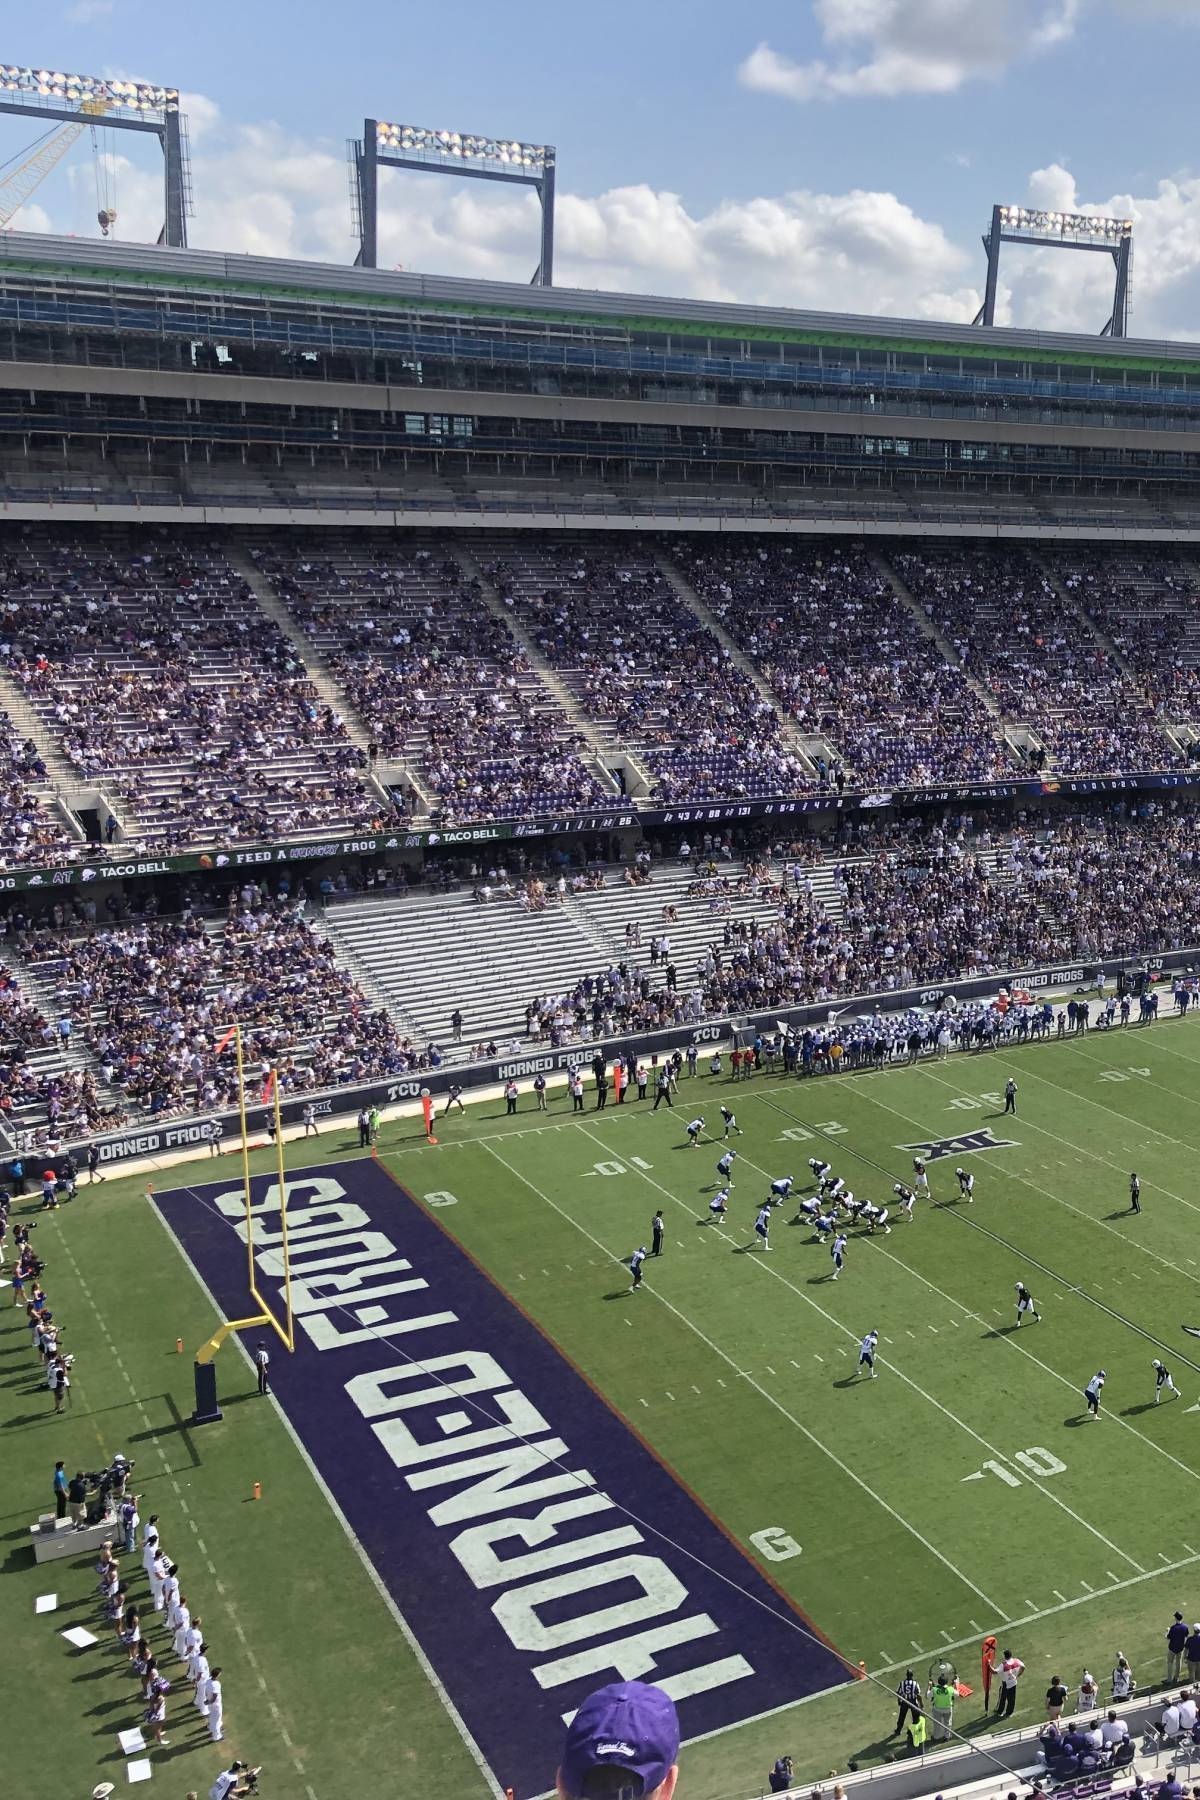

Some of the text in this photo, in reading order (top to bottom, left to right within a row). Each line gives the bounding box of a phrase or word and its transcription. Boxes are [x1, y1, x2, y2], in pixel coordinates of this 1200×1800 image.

[619, 816, 632, 826] 26
[678, 812, 690, 820] 43
[738, 807, 751, 816] 131
[404, 835, 422, 847] AT
[442, 831, 472, 842] TACO
[472, 828, 500, 839] BELL
[237, 840, 376, 864] FEED A HUNGRY FROG
[53, 870, 74, 884] AT
[100, 864, 136, 878] TACO
[138, 862, 170, 874] BELL
[1142, 958, 1163, 970] TCU
[1051, 968, 1084, 985] FROGS
[920, 991, 944, 1005] TCU
[693, 1026, 721, 1043] TCU
[498, 1058, 553, 1080] HORNED
[1103, 1066, 1152, 1082] 40
[388, 1083, 421, 1102] TCU
[949, 1092, 1006, 1110] 30
[784, 1121, 849, 1142] 20
[100, 1122, 222, 1162] ORNED FROG
[903, 1130, 1013, 1162] XII
[594, 1156, 654, 1175] 10
[423, 1190, 459, 1208] G
[214, 1175, 461, 1352] FROGS
[980, 1447, 1068, 1487] 10
[344, 1350, 757, 1729] HORNED
[748, 1526, 802, 1562] G
